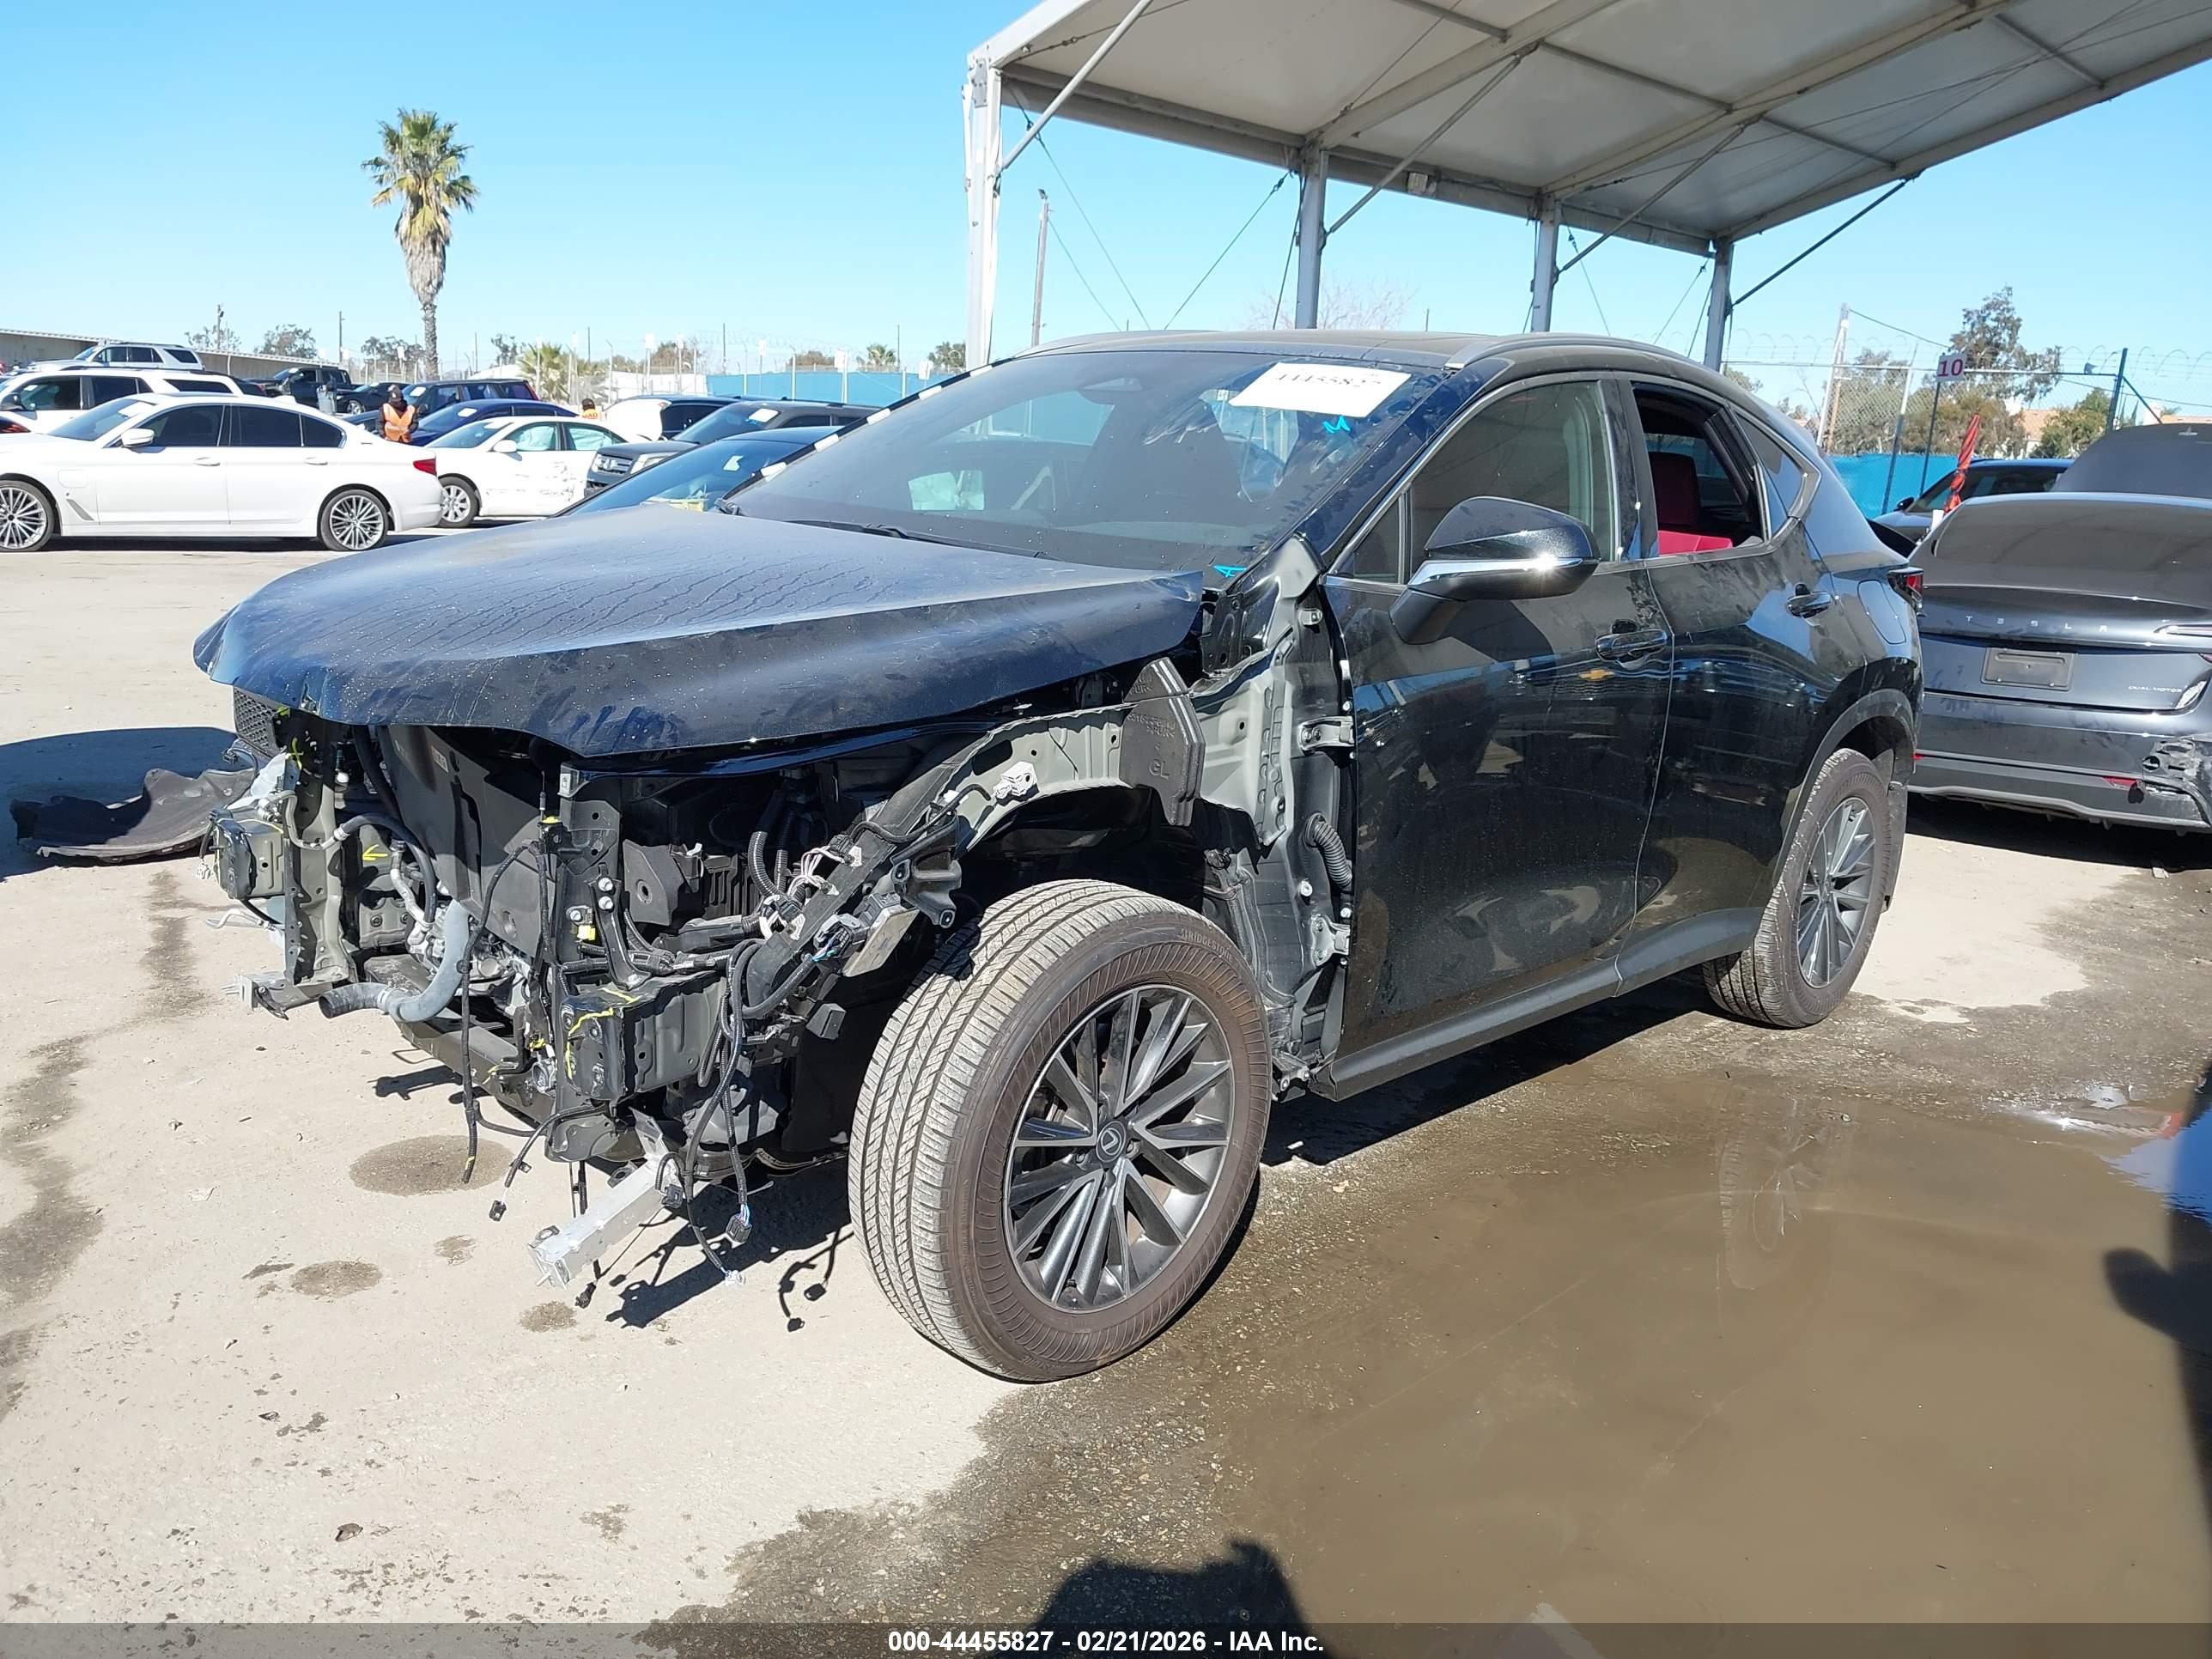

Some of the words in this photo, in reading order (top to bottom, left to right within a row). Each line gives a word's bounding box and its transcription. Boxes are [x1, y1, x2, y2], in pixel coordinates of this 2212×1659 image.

[1937, 358, 1964, 377] 10
[1966, 615, 2108, 633] TESLA
[1180, 927, 1234, 963] BRIDGESTONE
